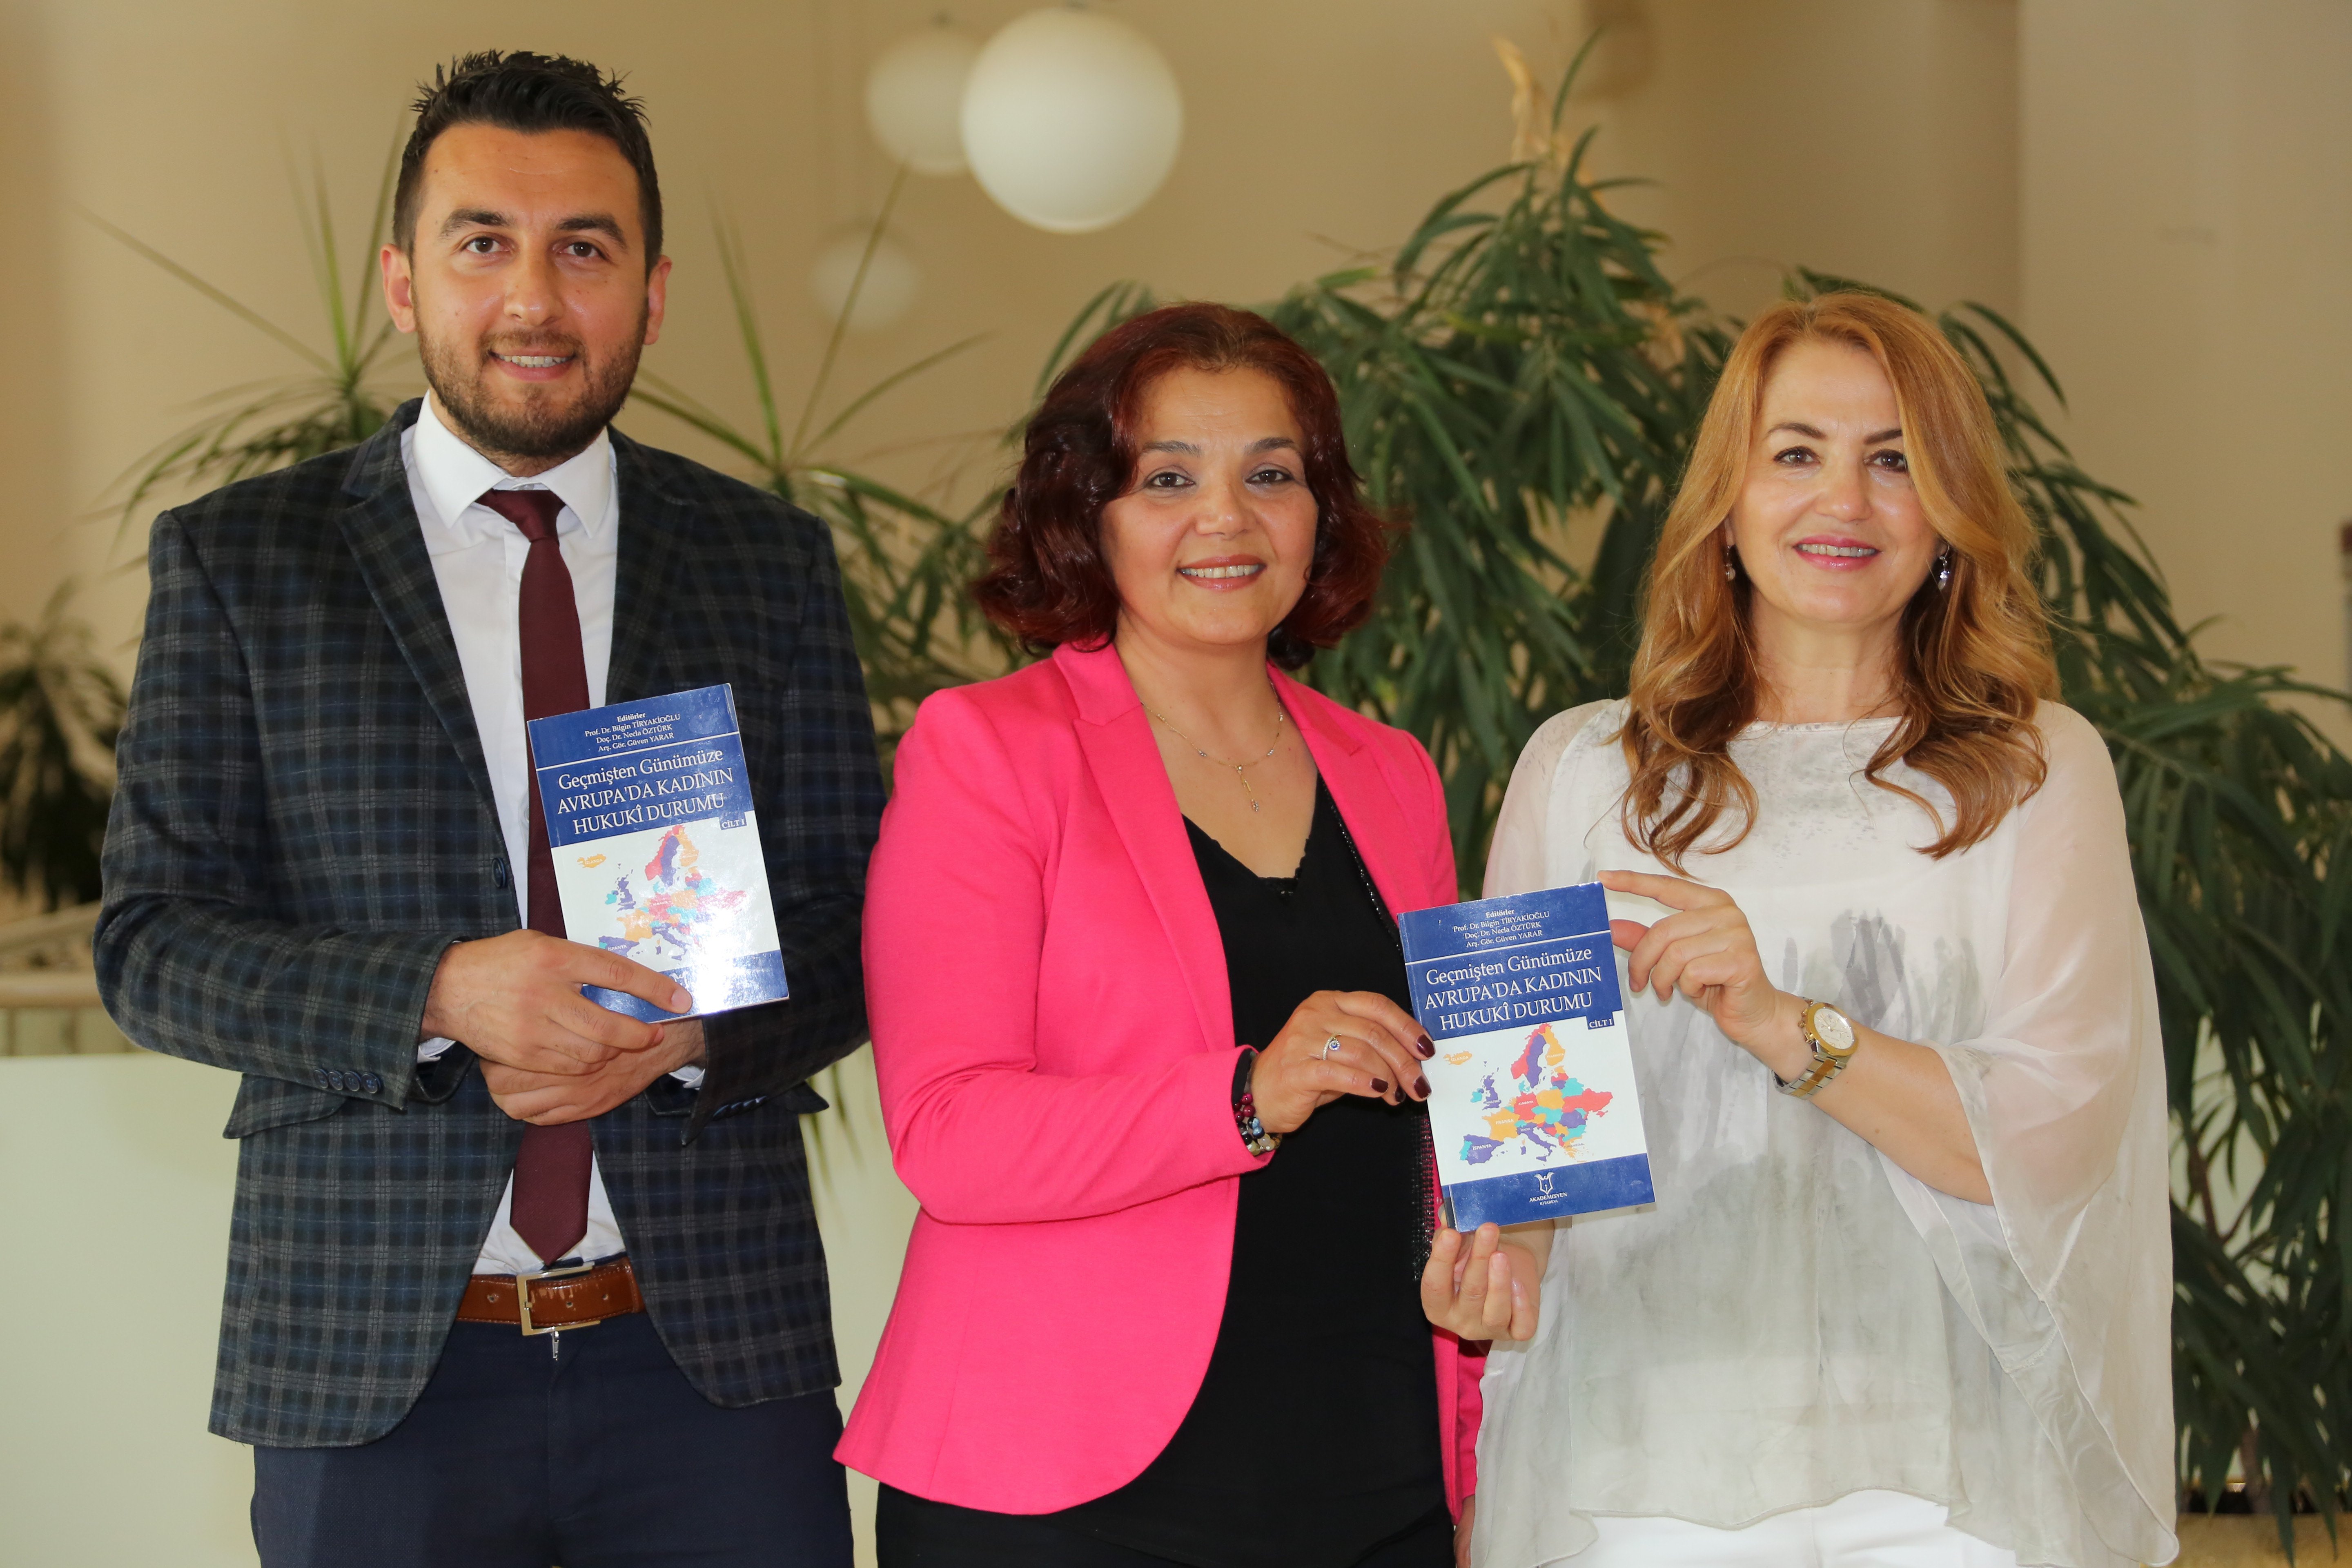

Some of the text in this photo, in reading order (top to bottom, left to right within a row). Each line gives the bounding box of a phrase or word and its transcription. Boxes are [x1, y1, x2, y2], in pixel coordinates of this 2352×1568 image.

[617, 713, 646, 722] Editörler
[612, 724, 631, 732] Bilgin
[623, 730, 641, 738] Necla
[642, 724, 673, 735] ÖZTÜRK
[627, 738, 649, 746] Güven
[649, 732, 674, 742] YARAR
[558, 748, 724, 790] Geçmişten Günümüze
[557, 768, 733, 815] AVRUPA'DA KADININ
[572, 793, 724, 835] HUKUKÎ DURUMU
[722, 820, 739, 828] CİLT
[1481, 920, 1500, 929] Bilgin
[1501, 911, 1550, 924] TİRYAKİOĞLU
[1485, 909, 1515, 918] Editörler
[1491, 926, 1510, 935] Necla
[1511, 921, 1541, 931] ÖZTÜRK
[1495, 934, 1517, 943] Güven
[1517, 930, 1543, 939] YARAR
[1426, 946, 1592, 986] Geçmişten Günümüze
[1424, 966, 1601, 1010] AVRUPA'DA KADININ
[1439, 991, 1592, 1031] HUKUKÎ DURUMU
[1589, 1019, 1607, 1028] CİLT
